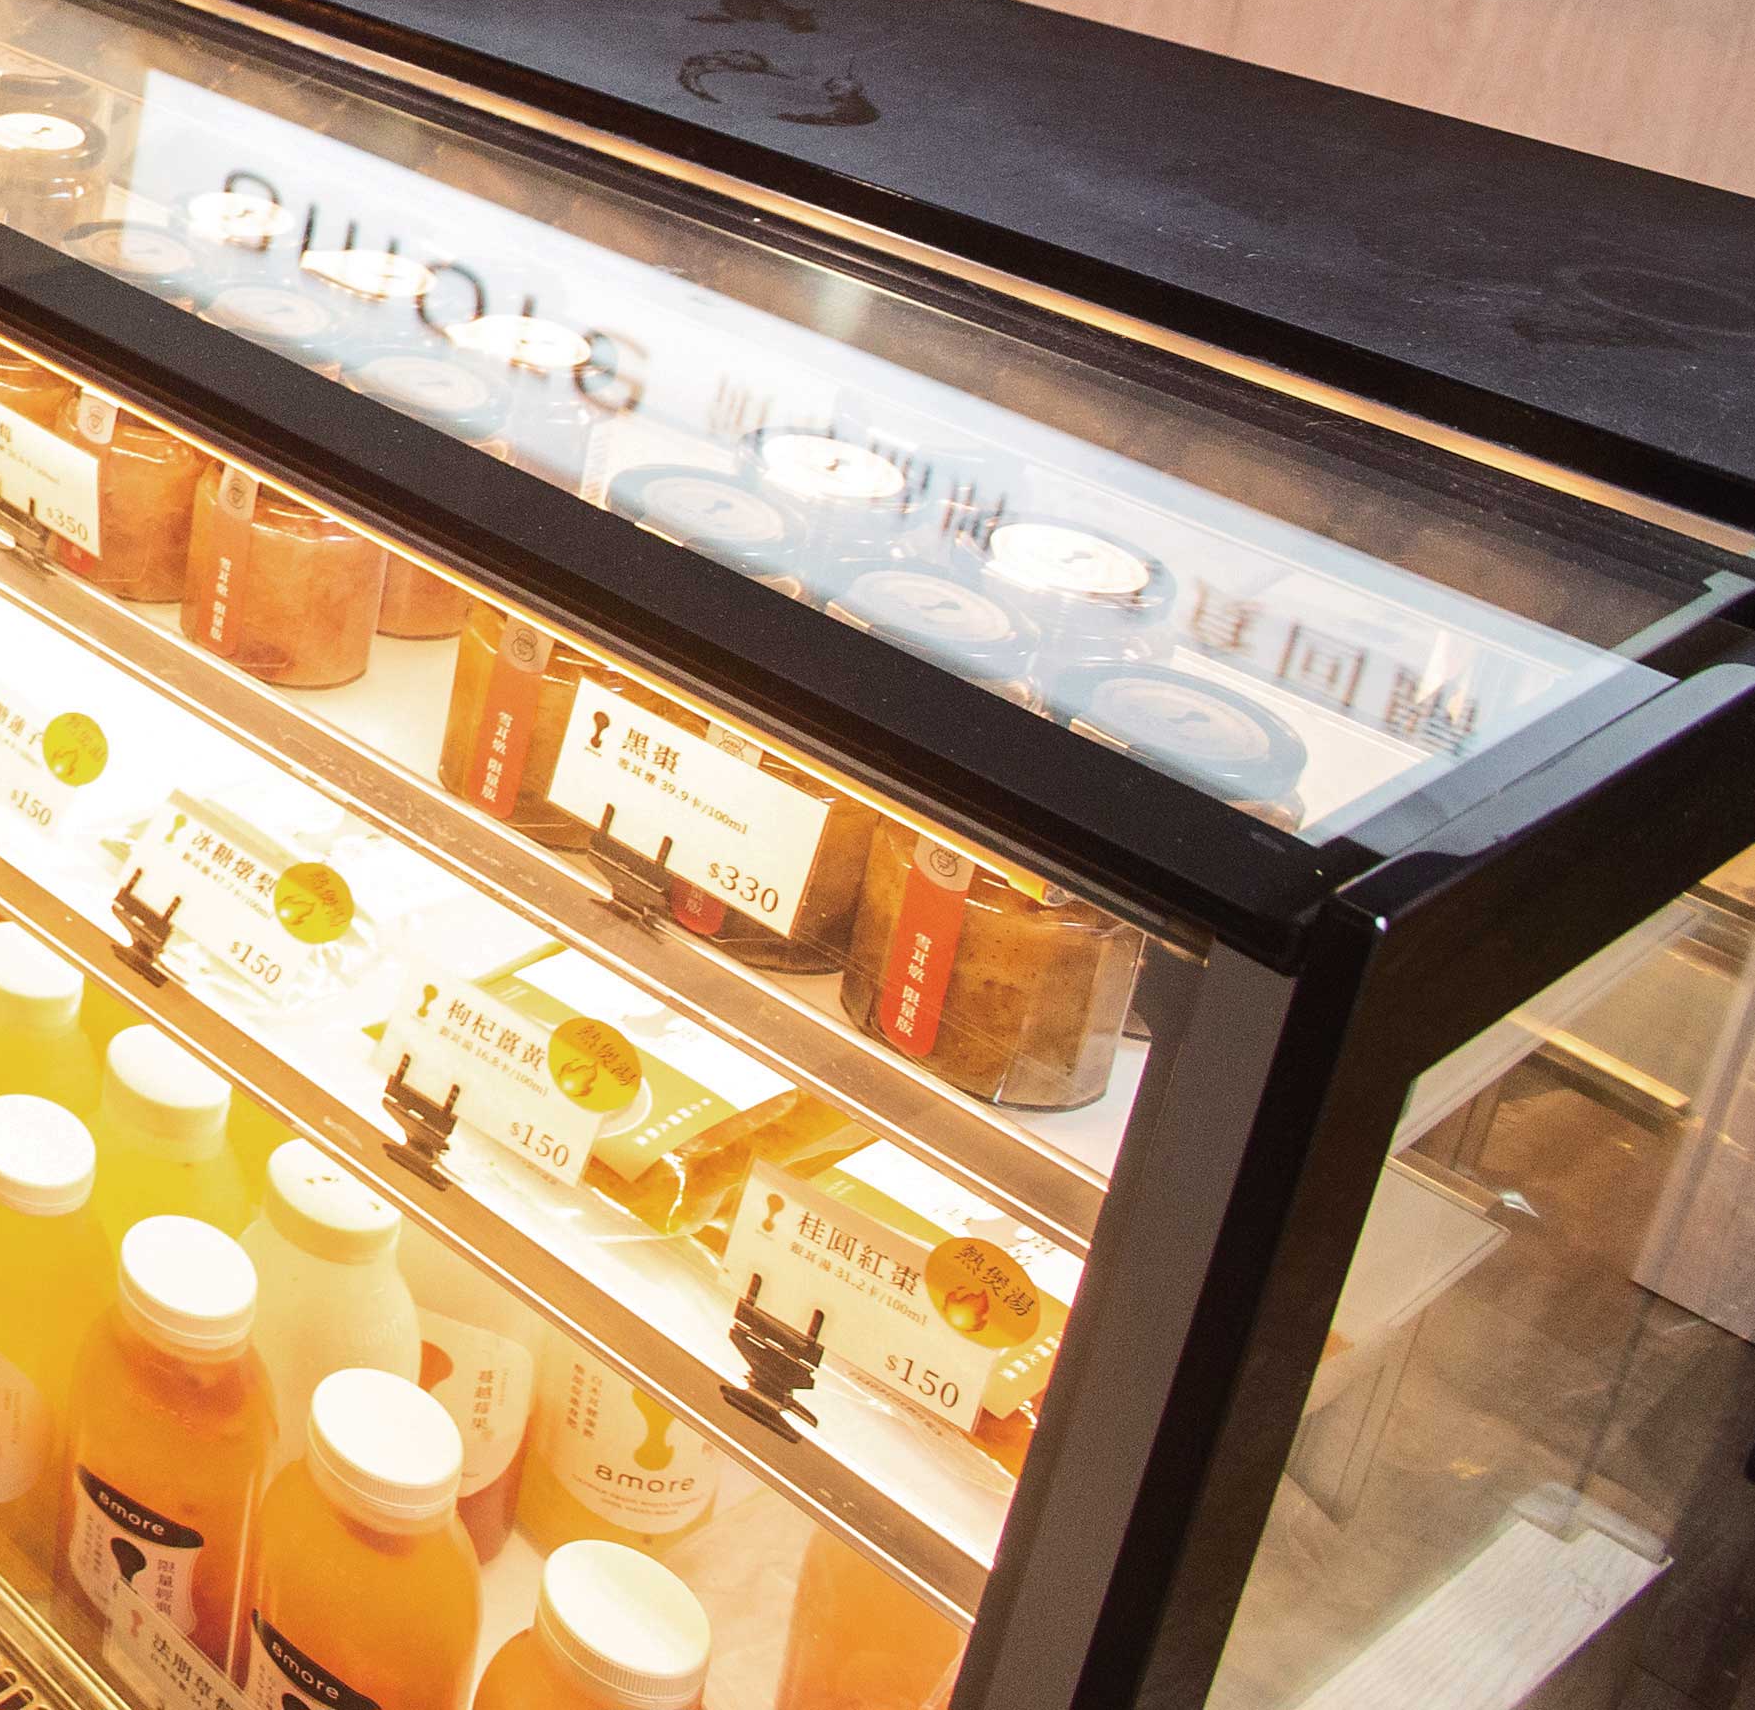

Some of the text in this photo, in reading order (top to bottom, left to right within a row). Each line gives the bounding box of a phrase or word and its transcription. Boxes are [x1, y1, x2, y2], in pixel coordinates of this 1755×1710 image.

[46, 506, 89, 542] $350
[621, 728, 681, 775] 黑棗
[10, 788, 54, 827] $150
[191, 829, 277, 899] 冰糖燉梨
[706, 860, 780, 914] $330
[229, 940, 283, 986] $150
[447, 998, 547, 1073] 枸杞薑黃
[894, 985, 920, 1038] 限量版
[509, 1120, 570, 1169] $150
[954, 1241, 1037, 1318] 熱煲湯
[883, 1352, 961, 1410] $150
[97, 1490, 167, 1538] 8more
[270, 1640, 341, 1702] 8more
